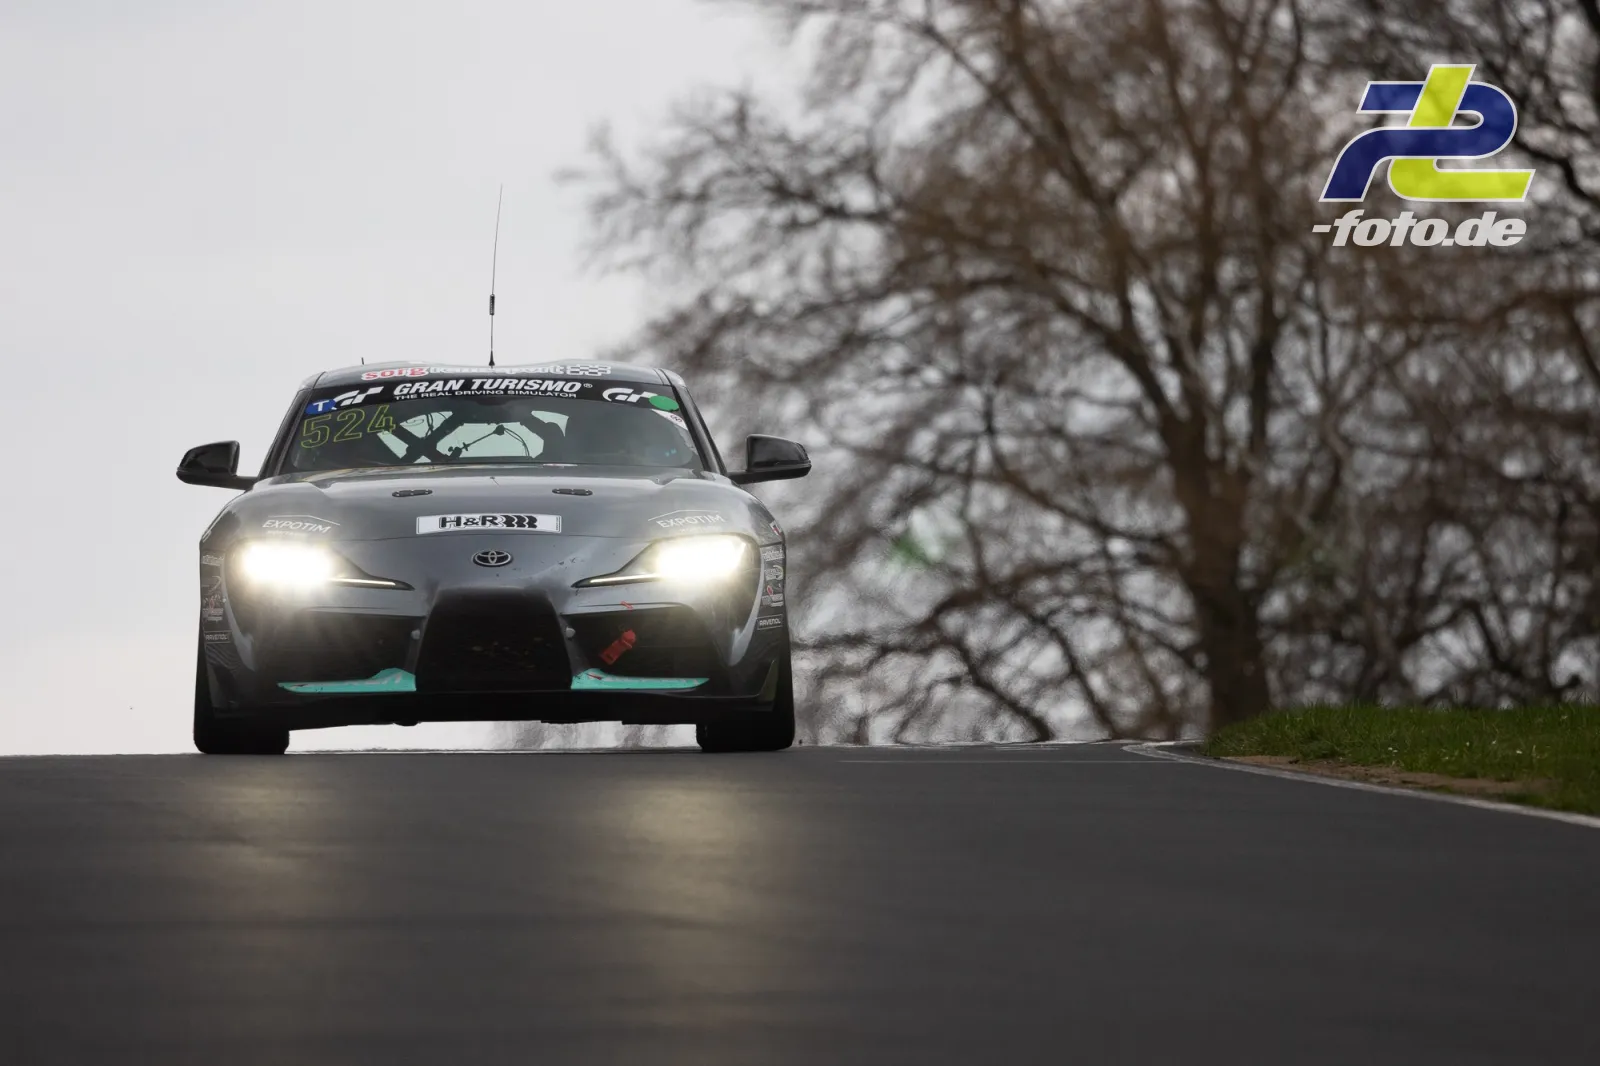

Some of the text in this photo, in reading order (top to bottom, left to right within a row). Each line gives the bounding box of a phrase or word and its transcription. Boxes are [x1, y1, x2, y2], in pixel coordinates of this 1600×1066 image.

[393, 379, 464, 396] GRAN
[420, 391, 452, 399] REAL
[507, 390, 577, 399] SIMULATOR
[301, 404, 396, 449] 524
[262, 519, 332, 533] EXPOTIM
[655, 514, 726, 528] EXPOTIM
